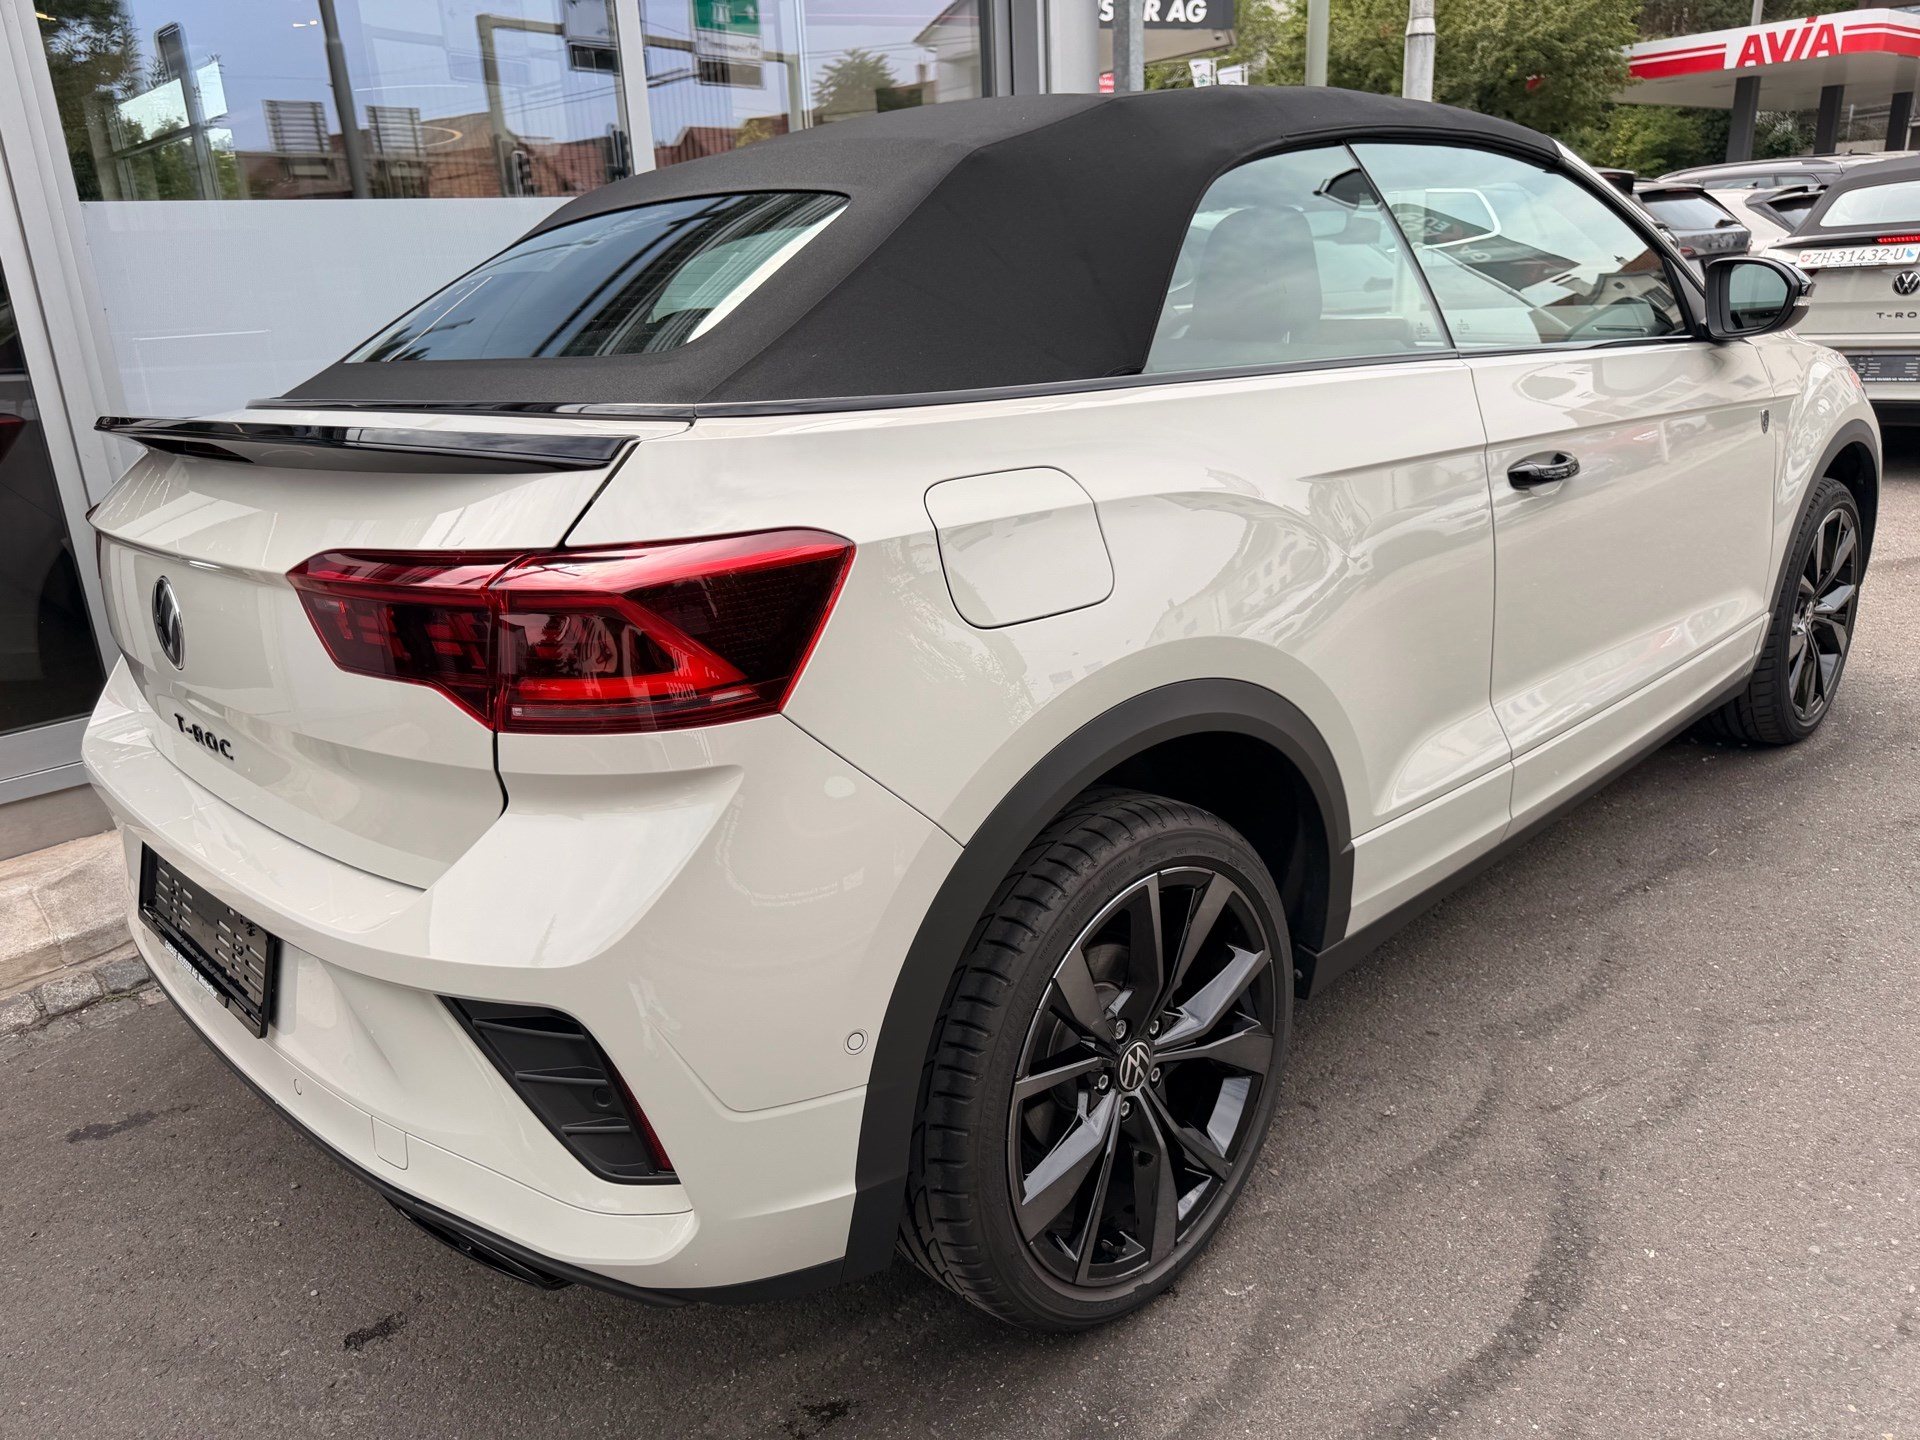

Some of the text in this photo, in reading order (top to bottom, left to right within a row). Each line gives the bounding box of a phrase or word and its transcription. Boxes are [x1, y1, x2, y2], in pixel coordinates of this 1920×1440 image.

[1098, 0, 1208, 22] SR AG
[1736, 16, 1840, 69] AVIA
[174, 712, 235, 761] T-ROC
